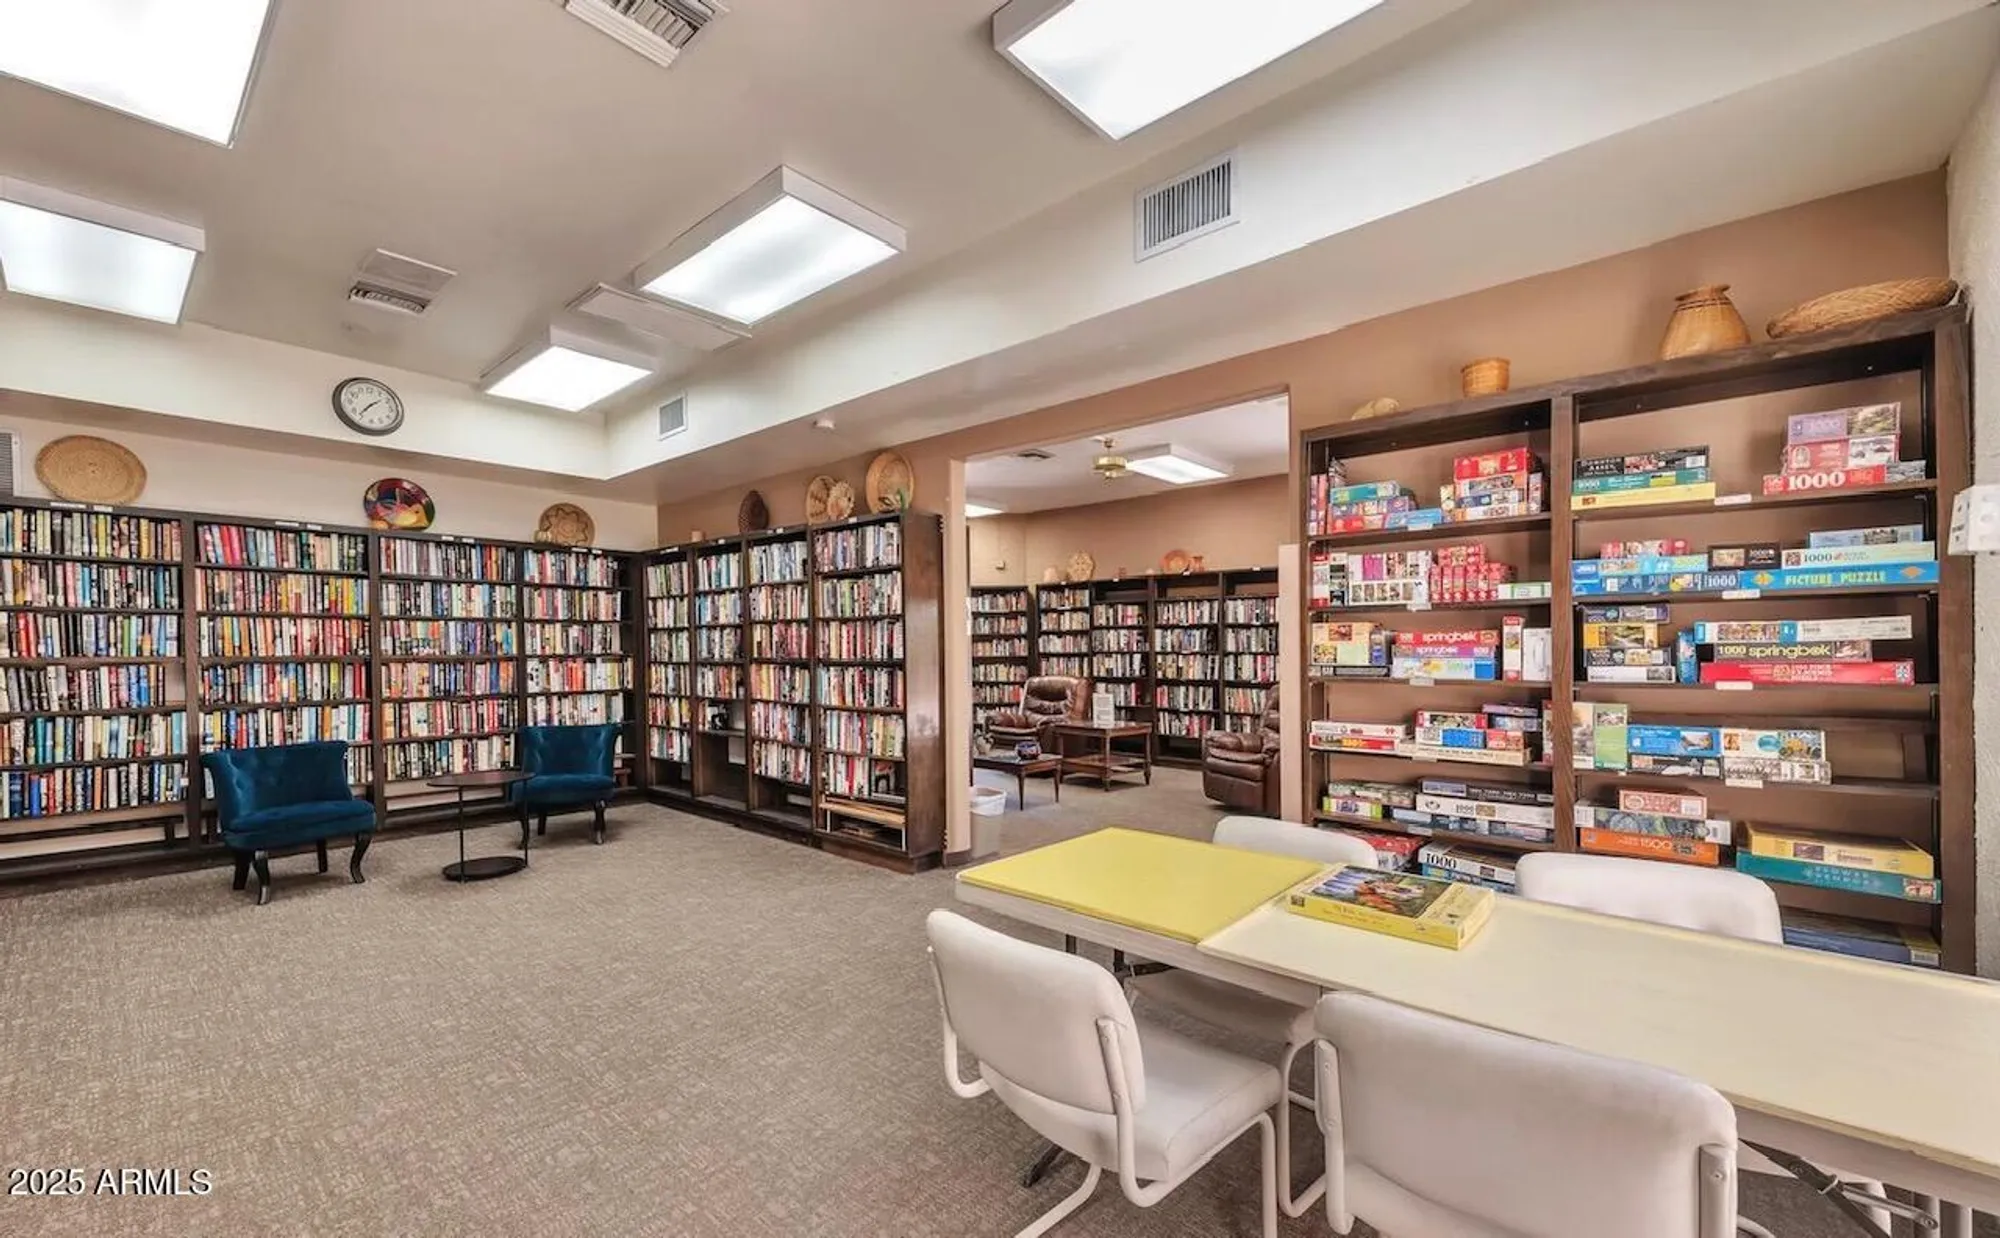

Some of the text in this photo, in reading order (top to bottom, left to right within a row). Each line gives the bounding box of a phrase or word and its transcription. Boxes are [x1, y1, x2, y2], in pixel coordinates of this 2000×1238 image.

[1787, 470, 1847, 491] 1000
[1804, 553, 1832, 563] 1000
[1707, 574, 1737, 588] 1000
[1784, 570, 1887, 586] PICTURE PUZZLE
[1423, 630, 1477, 643] springbok
[1719, 643, 1832, 659] 1000 springbok
[1426, 852, 1457, 869] 1000
